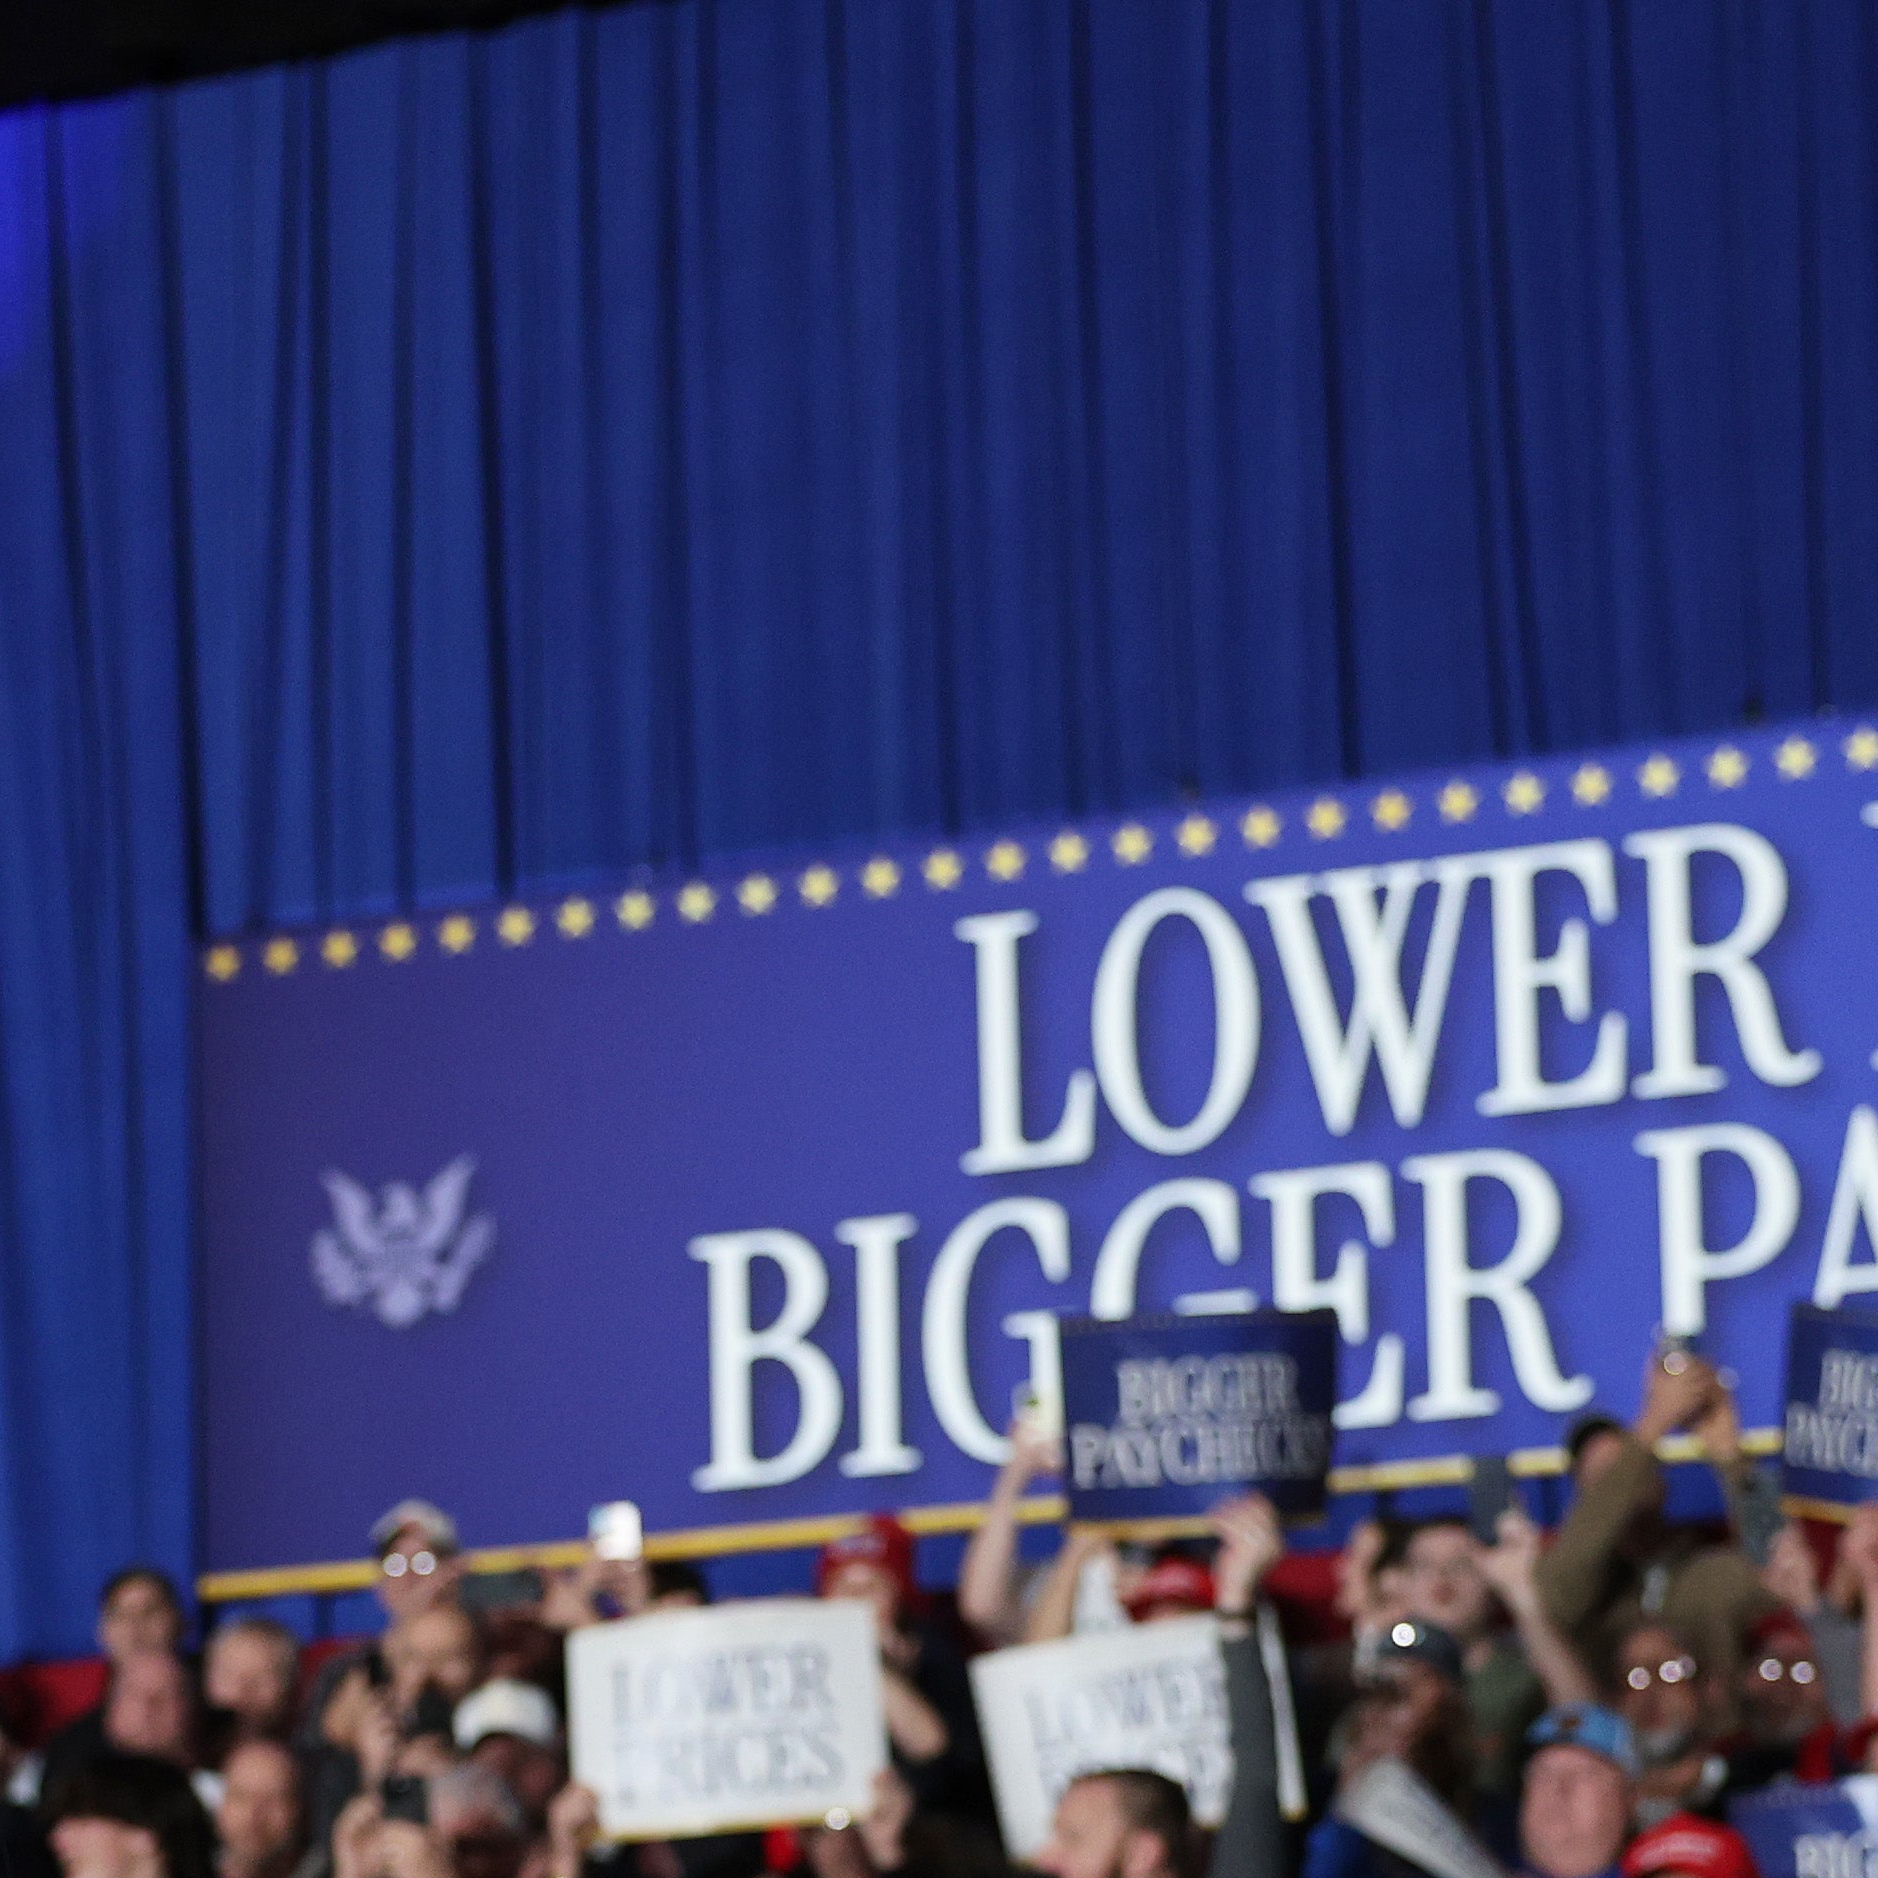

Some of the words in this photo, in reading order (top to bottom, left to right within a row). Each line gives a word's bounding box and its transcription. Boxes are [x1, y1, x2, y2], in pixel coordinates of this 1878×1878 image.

[953, 822, 1823, 1177] LOWER
[609, 1640, 835, 1728] LOWER
[611, 1722, 849, 1810] PRICES
